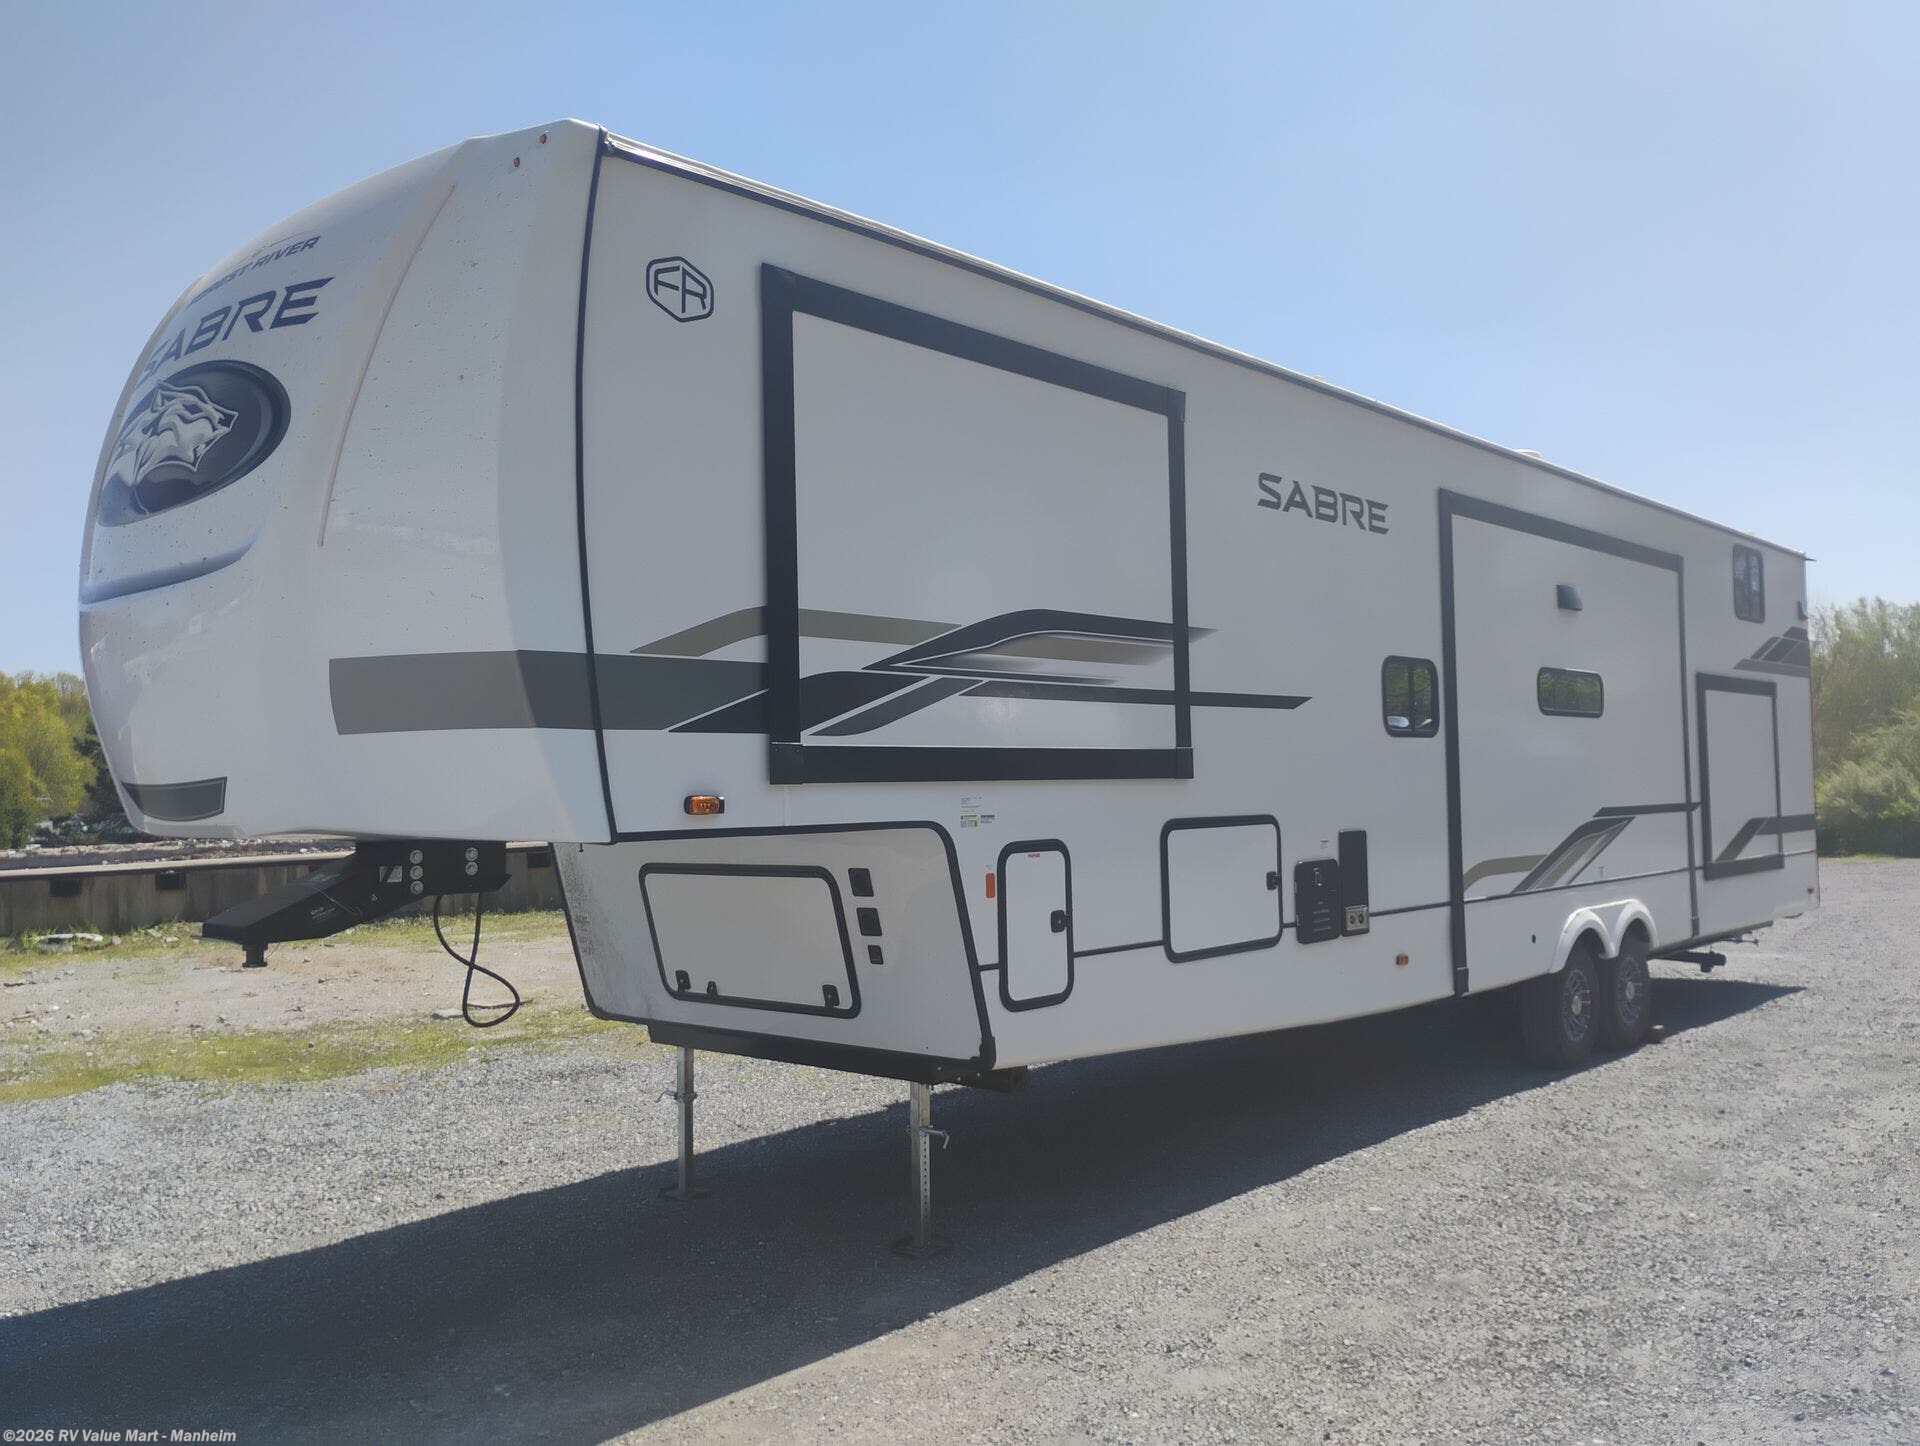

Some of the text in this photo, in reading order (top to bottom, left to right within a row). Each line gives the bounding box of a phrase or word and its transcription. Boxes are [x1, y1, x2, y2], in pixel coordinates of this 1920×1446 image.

[252, 236, 321, 270] RIVER
[133, 276, 336, 390] SABRE
[1257, 472, 1390, 535] SABRE
